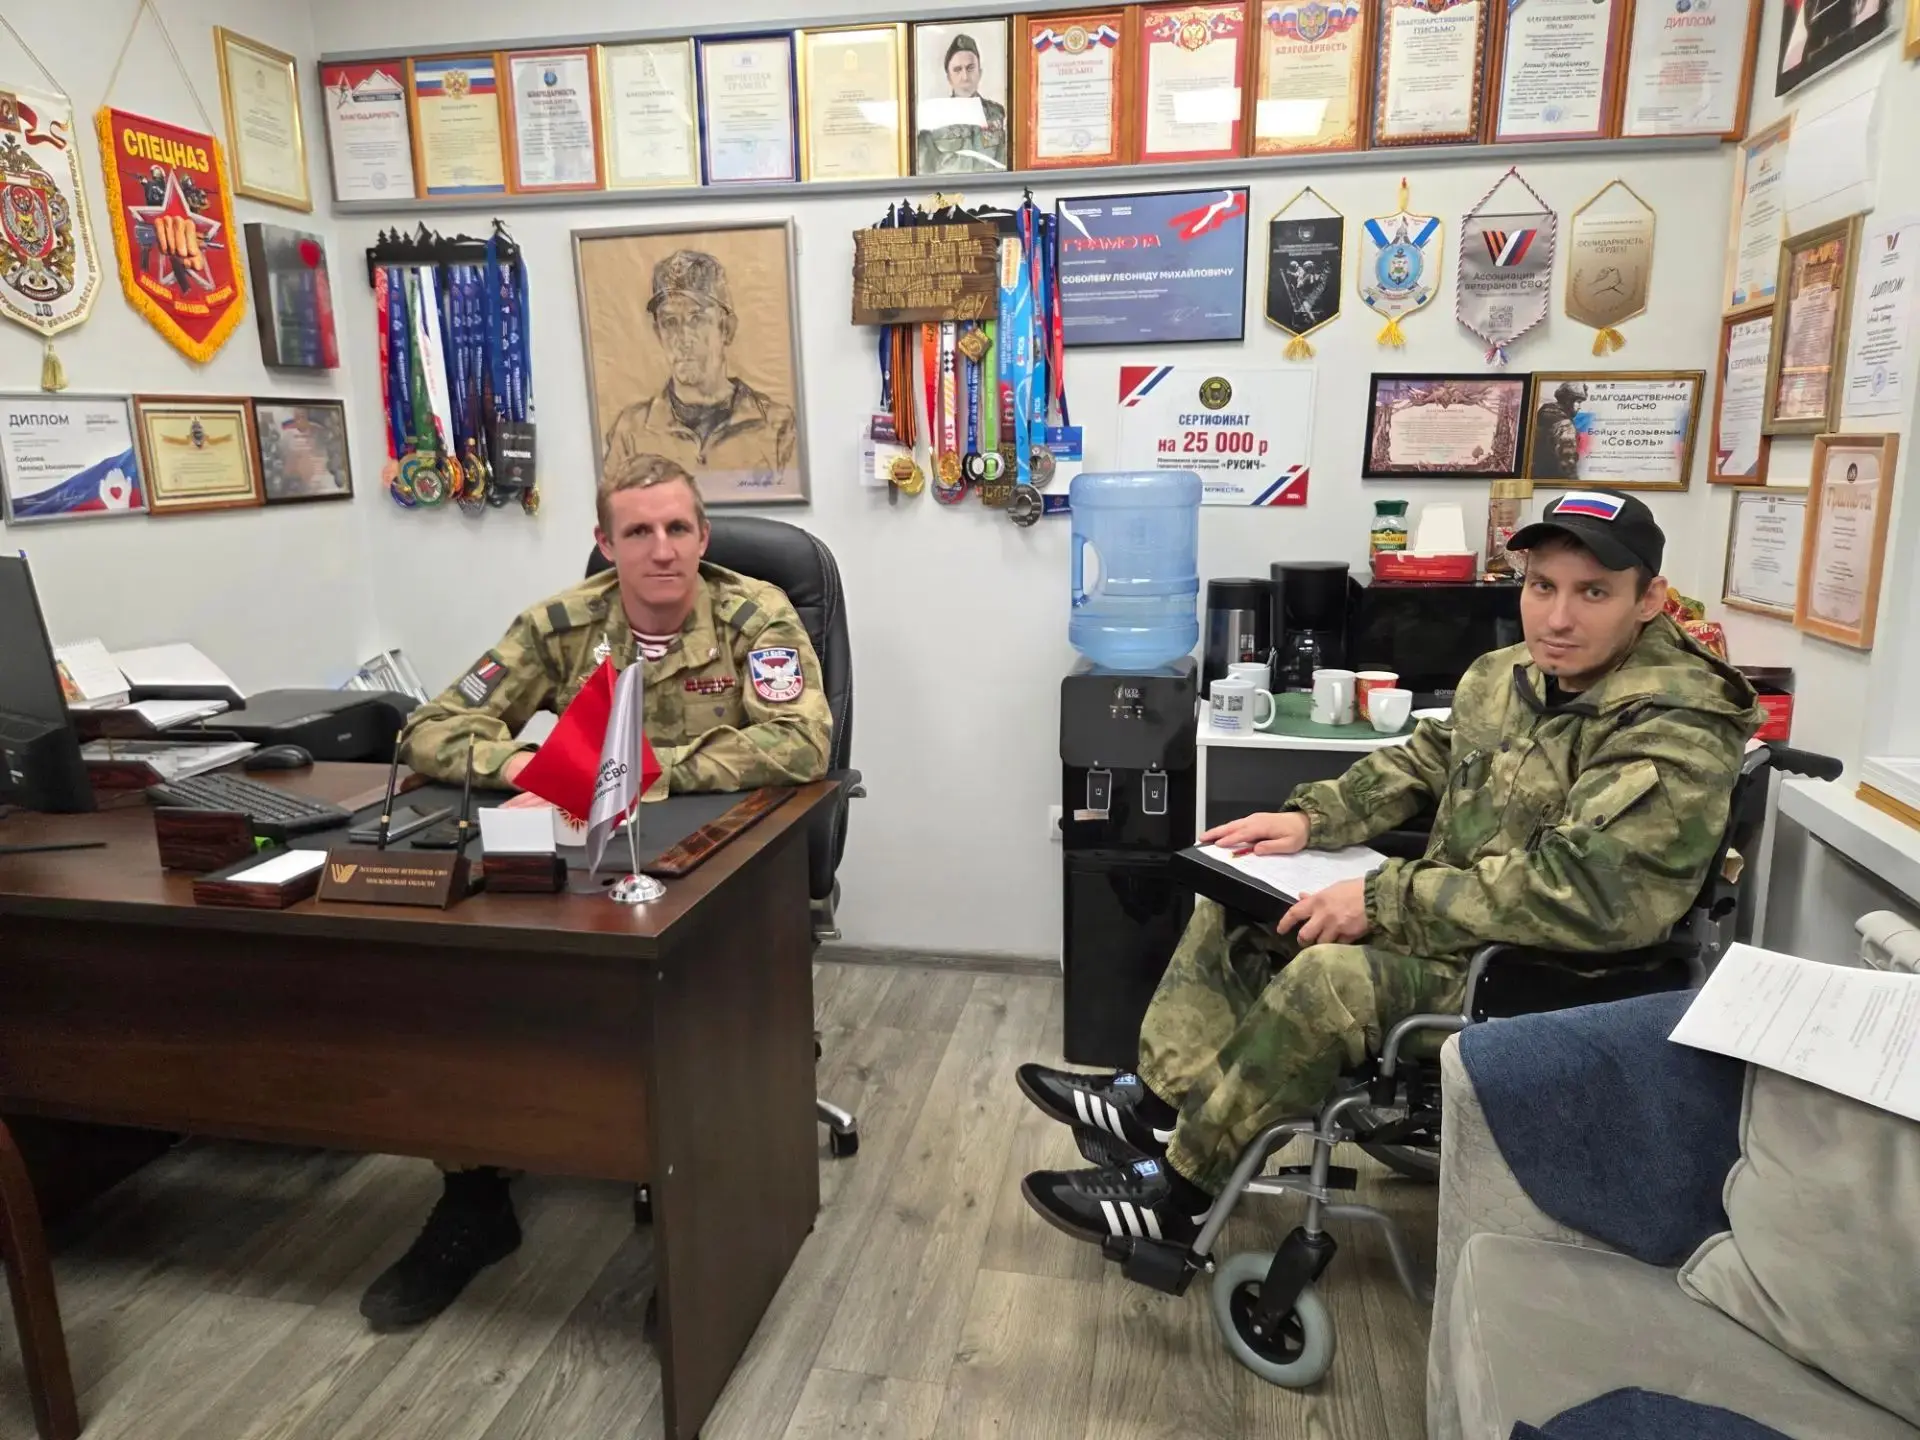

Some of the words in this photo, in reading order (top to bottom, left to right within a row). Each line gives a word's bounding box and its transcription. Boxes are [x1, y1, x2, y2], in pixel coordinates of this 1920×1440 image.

[1664, 15, 1716, 30] ДИПЛОМ
[123, 128, 209, 172] СПЕЦНАЗ
[1062, 273, 1113, 284] СОБОЛЕВУ
[1113, 271, 1159, 282] ЛЕОНИДУ
[1159, 267, 1234, 280] МИХАЙЛОВИЧУ
[1473, 271, 1535, 281] Ассоциация
[1464, 282, 1518, 291] ветеранов
[1520, 279, 1542, 289] СВО
[1590, 393, 1688, 401] БЛАГОДАРСТВЕННОЕ
[1617, 402, 1656, 410] ПИСЬМО
[9, 414, 70, 427] ДИПЛОМ
[1178, 414, 1250, 426] СЕРТИФИКАТ
[1587, 428, 1618, 436] Бойцу
[1157, 438, 1176, 453] на
[1183, 431, 1208, 453] 25
[1215, 431, 1254, 453] 000
[1259, 439, 1268, 456] р
[1221, 459, 1266, 470] «РУСИЧ»
[604, 763, 628, 782] СВО
